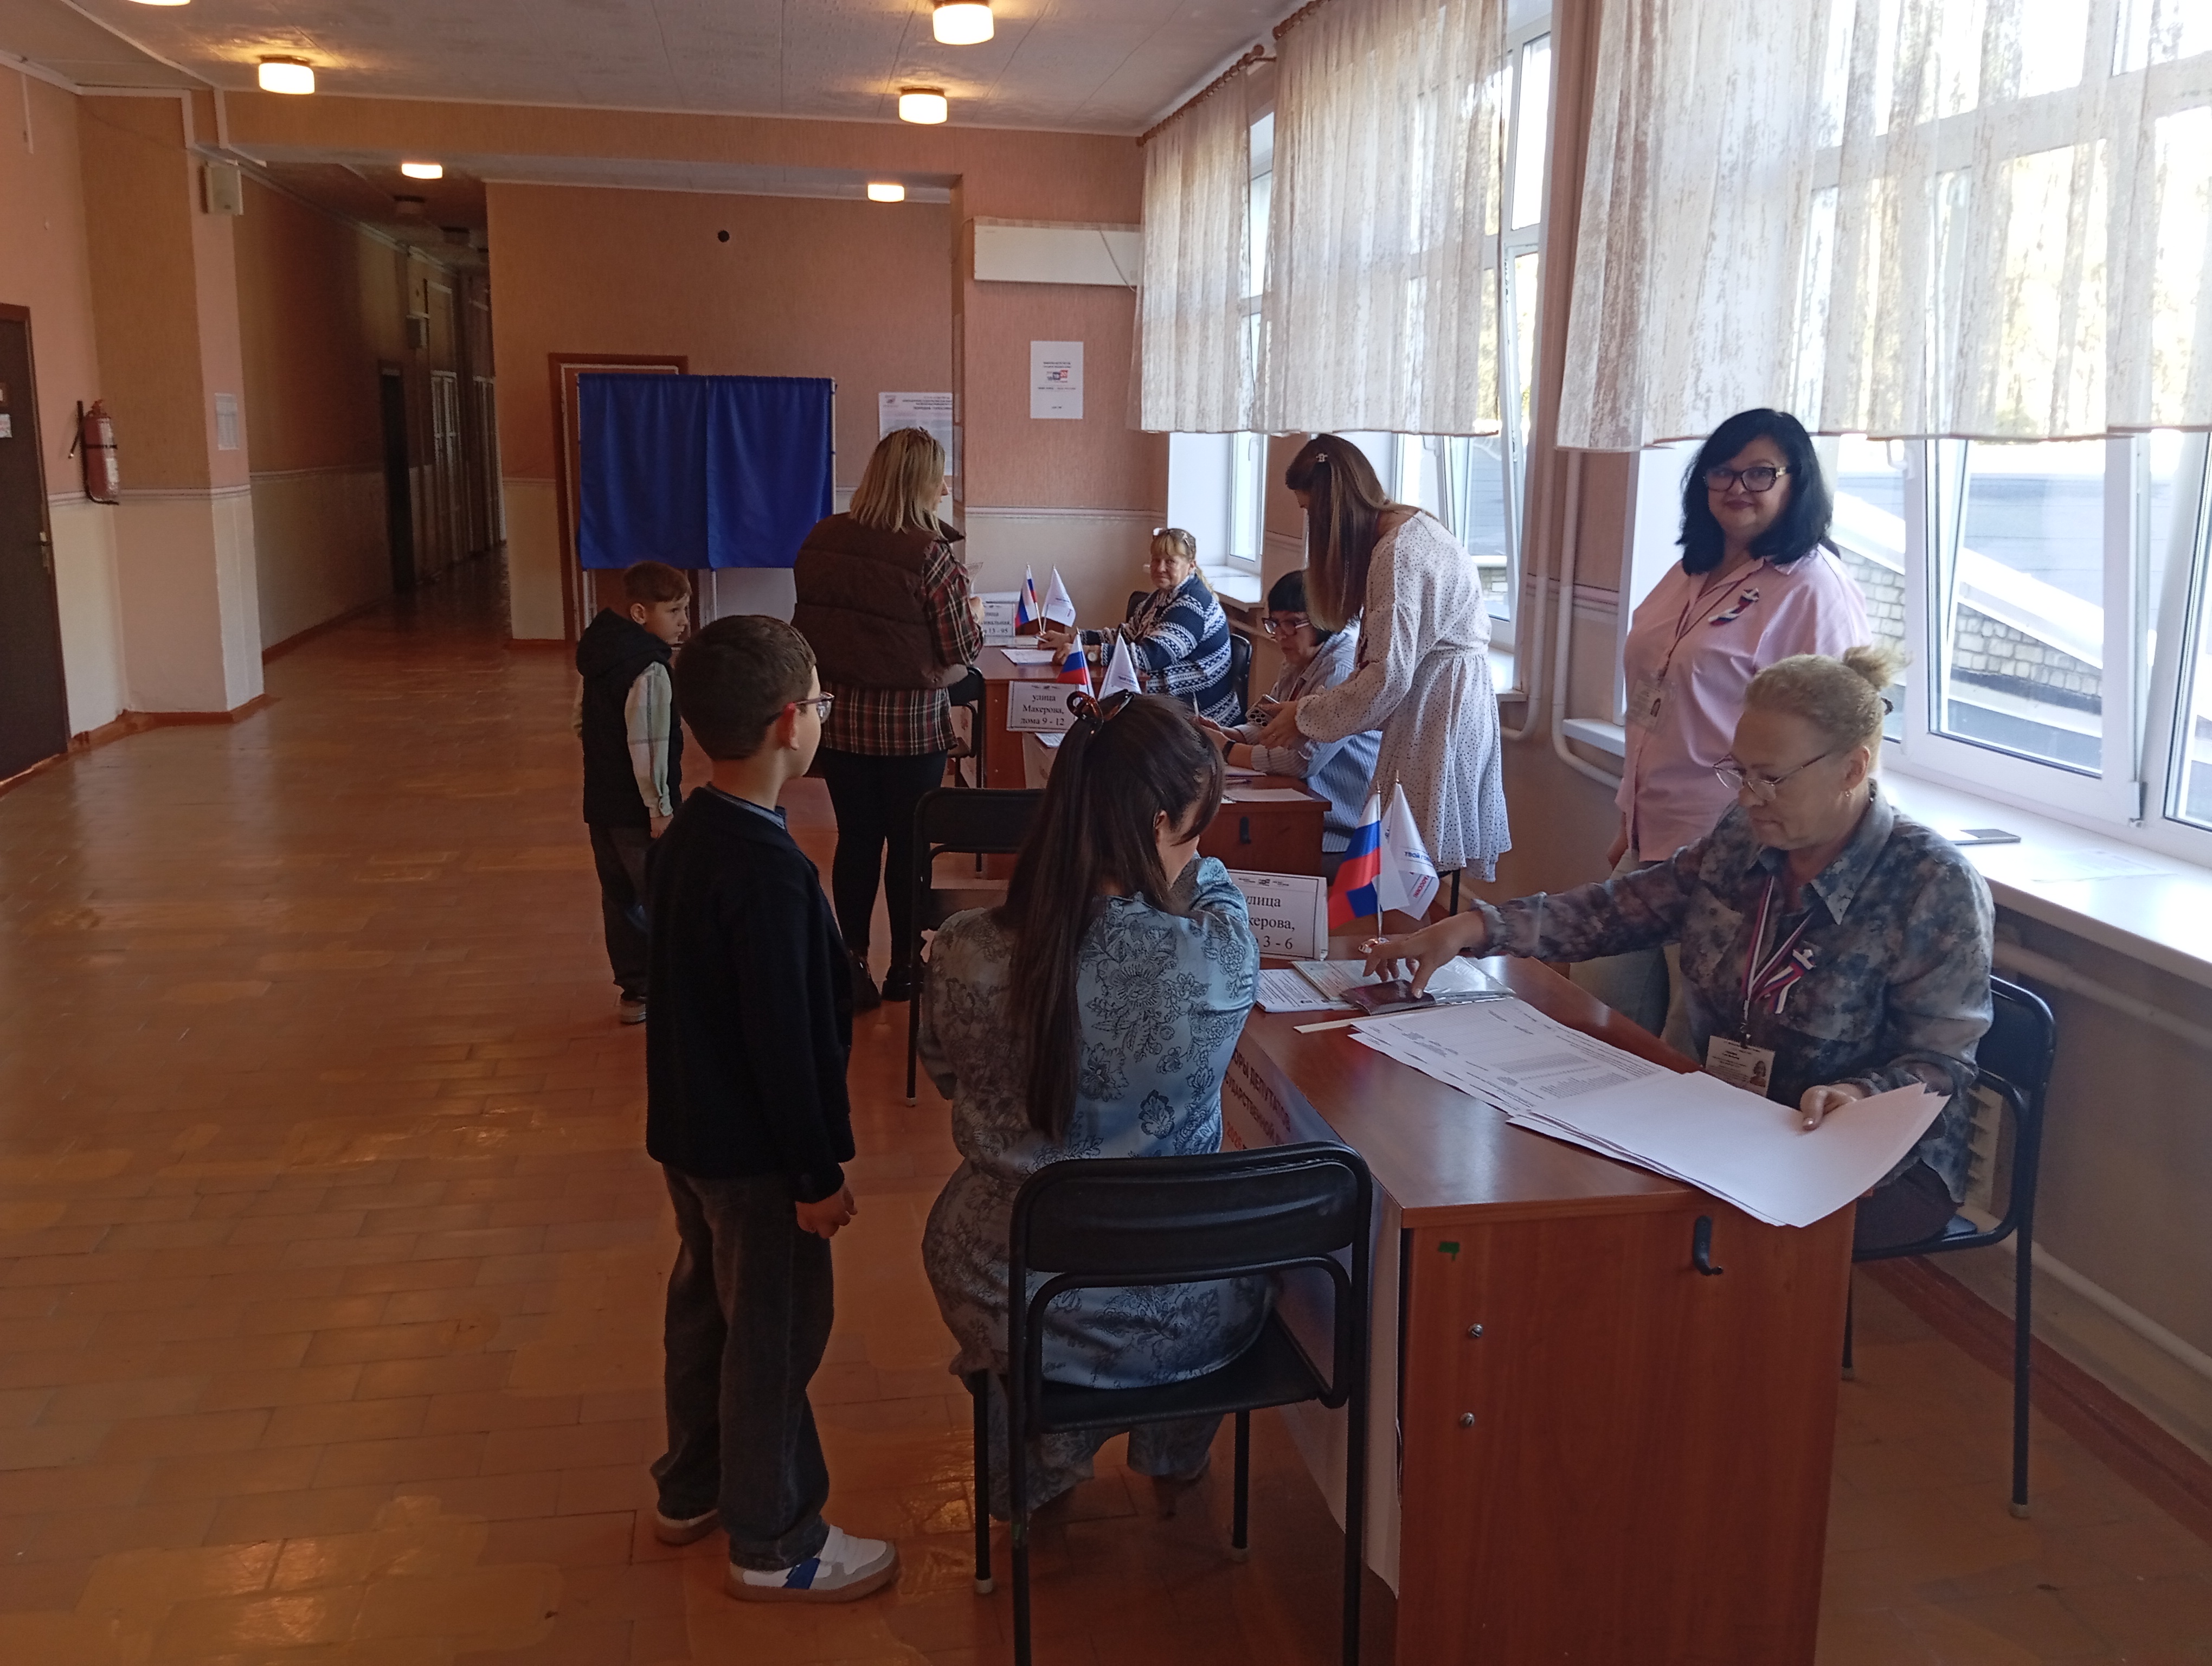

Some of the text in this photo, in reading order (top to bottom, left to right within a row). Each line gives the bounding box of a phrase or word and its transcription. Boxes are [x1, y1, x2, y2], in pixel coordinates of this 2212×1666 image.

[1023, 704, 1064, 715] Макерова,
[1056, 718, 1064, 726] 12
[1263, 935, 1271, 947] 3
[1285, 938, 1293, 950] 6
